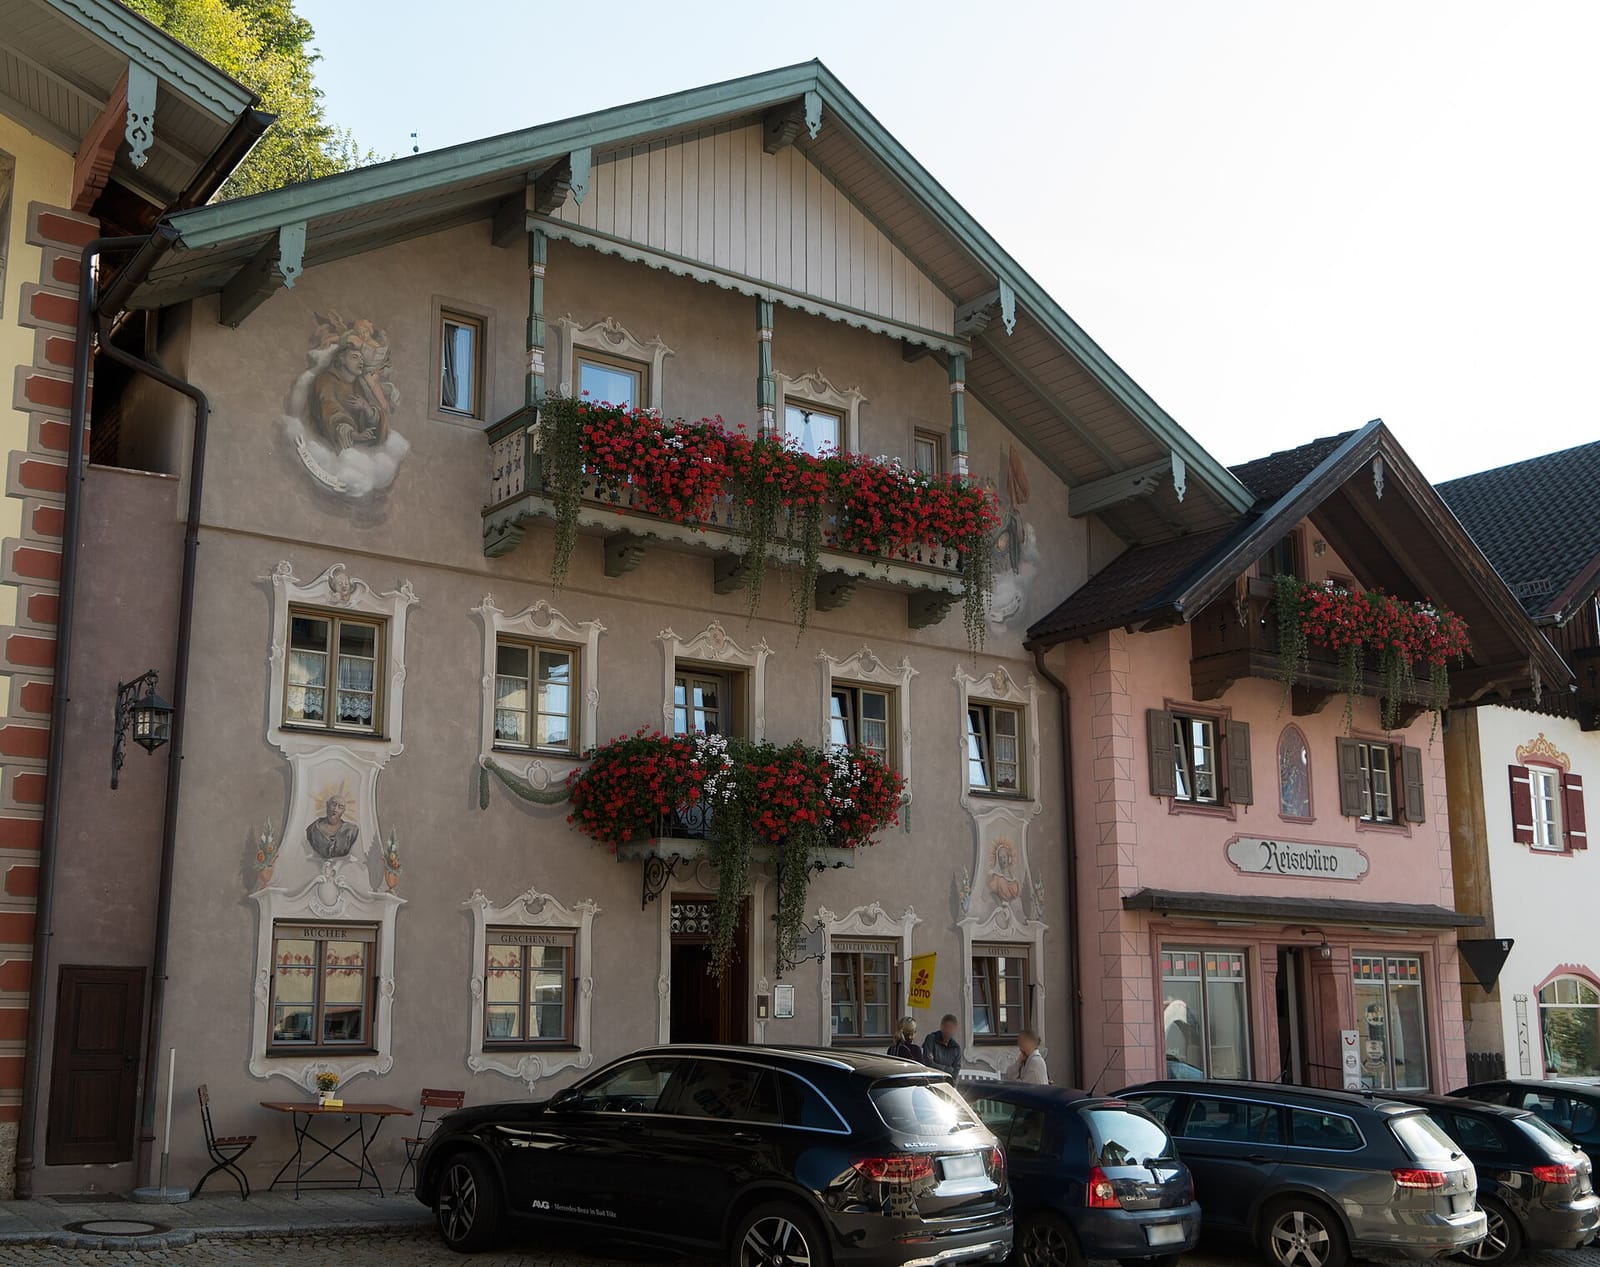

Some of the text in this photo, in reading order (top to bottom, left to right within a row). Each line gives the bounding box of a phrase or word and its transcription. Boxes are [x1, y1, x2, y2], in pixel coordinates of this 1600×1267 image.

[1258, 841, 1338, 874] Reisebüro
[303, 927, 348, 938] BÜCHER
[501, 934, 557, 945] GESCHENKE
[910, 988, 931, 998] LOTTO
